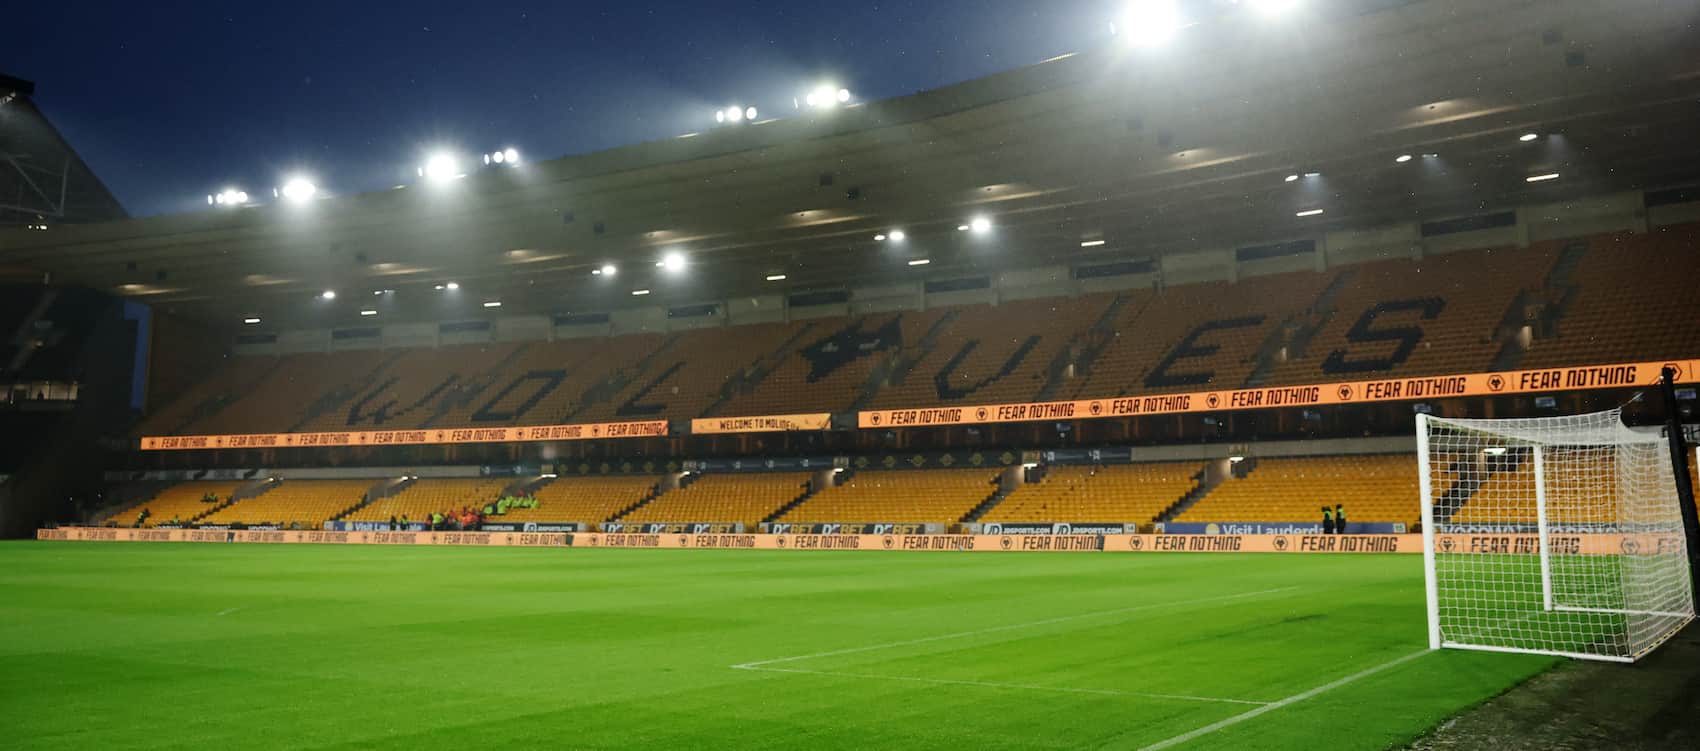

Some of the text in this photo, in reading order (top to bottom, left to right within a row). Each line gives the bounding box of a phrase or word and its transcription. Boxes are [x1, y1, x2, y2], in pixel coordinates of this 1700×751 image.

[1520, 366, 1637, 390] FEAR NOTHING
[1366, 377, 1466, 399] FEAR NOTHING
[1231, 387, 1320, 407] FEAR NOTHING
[1112, 395, 1190, 414] FEAR NOTHING
[890, 409, 962, 425] FEAR NOTHING
[999, 403, 1074, 420] FEAR NOTHING
[607, 422, 662, 436] FEAR NOTHING
[720, 418, 753, 431] WELCOME
[755, 418, 764, 429] TO
[374, 431, 427, 443] FEAR NOTHING
[452, 429, 507, 441] FEAR NOTHING
[531, 426, 582, 439] FEAR NOTHING
[300, 434, 319, 445] FEAR
[1222, 524, 1338, 534] Visit Lauderda
[520, 535, 572, 545] FEAR NOTHIN
[605, 535, 659, 546] FEAR NOTHING
[696, 535, 755, 547] FEAR NOTHING
[794, 536, 859, 548] FEAR NOTHING
[903, 536, 975, 549] FEAR NOTHING
[1023, 536, 1051, 550] FEAR
[1155, 536, 1242, 551] FEAR NOTHING
[1301, 536, 1398, 552] FEAR NOTHING
[1471, 536, 1509, 553] FEAR
